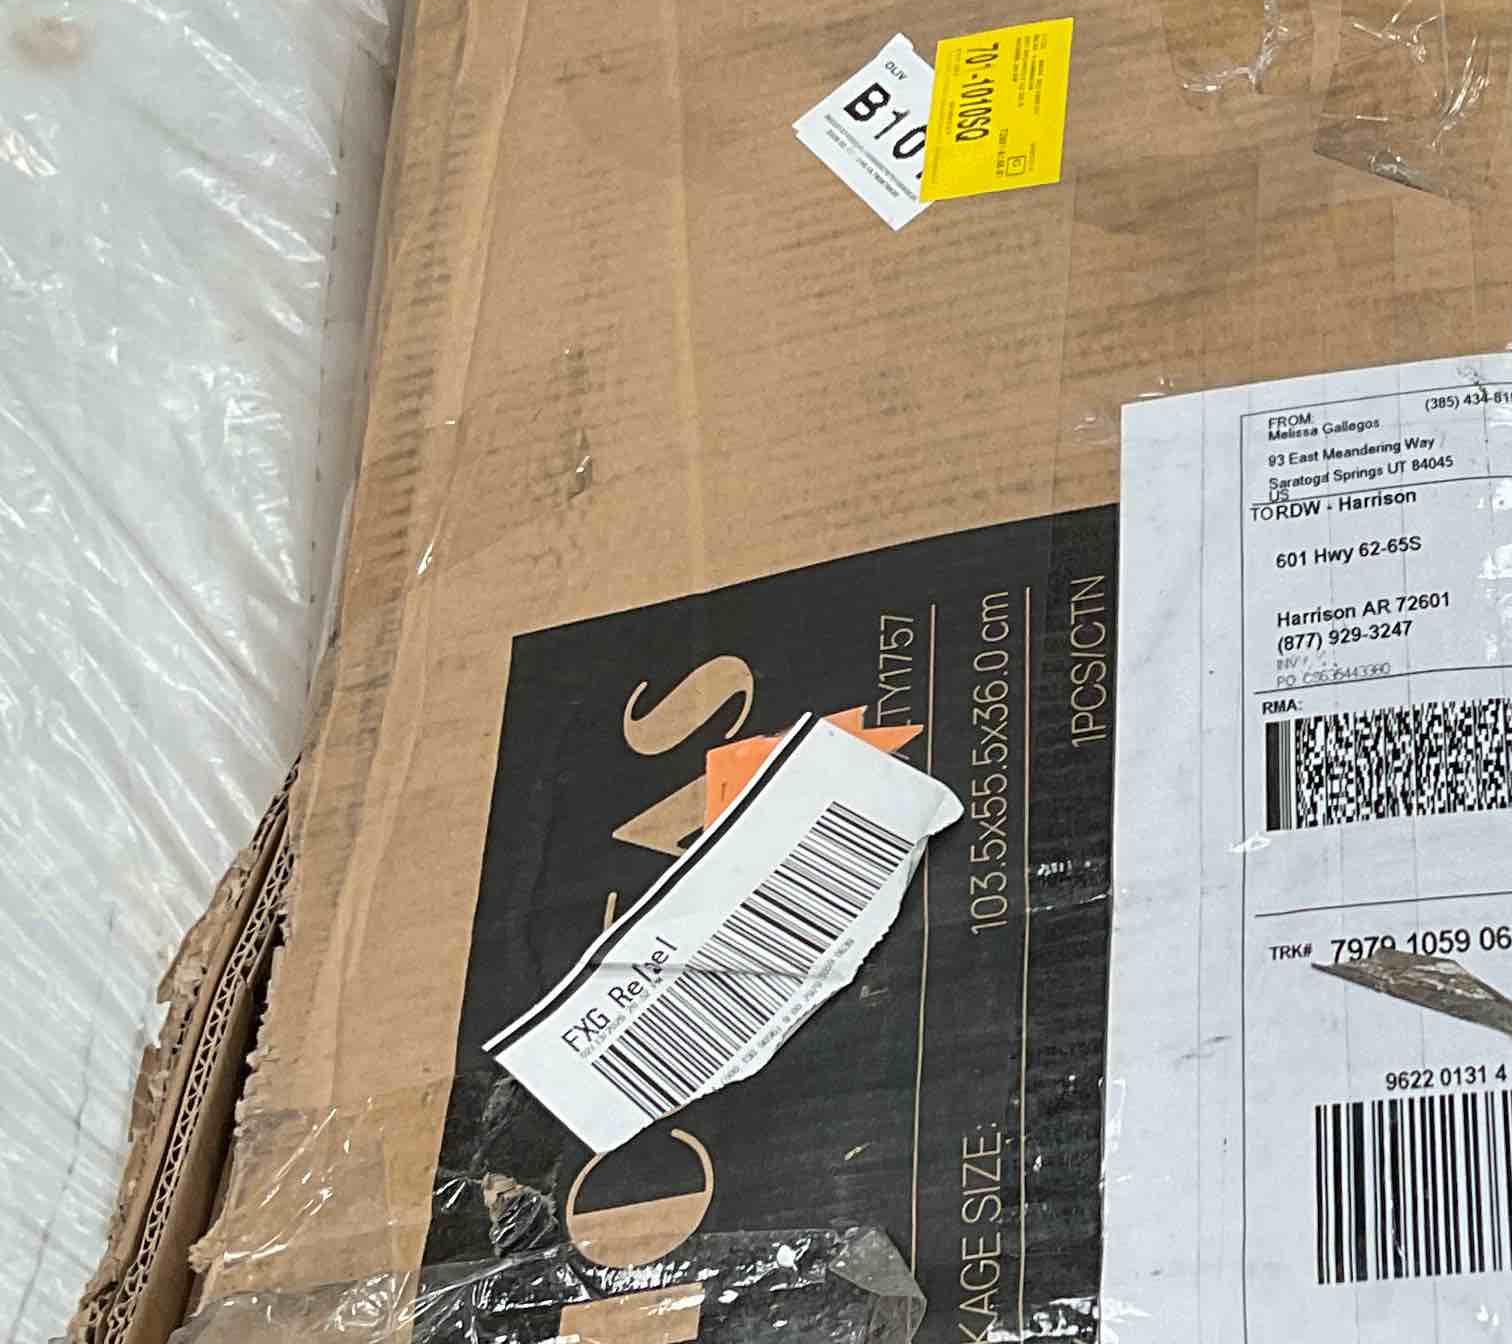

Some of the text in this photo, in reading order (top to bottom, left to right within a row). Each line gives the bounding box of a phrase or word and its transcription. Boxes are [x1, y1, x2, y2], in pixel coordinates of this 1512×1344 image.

[843, 82, 928, 180] B10
[1425, 395, 1460, 412] (385)
[1268, 419, 1380, 441] Melissa Gallegos
[1268, 436, 1436, 467] 93 East Meandering Way
[1269, 455, 1454, 489] Saratoga Springs UT 84045
[1269, 489, 1290, 503] US
[1339, 490, 1417, 512] Harrison
[1276, 535, 1422, 569] 601 Hwy 62-65S
[1277, 591, 1450, 628] Harrison AR 72601
[1277, 620, 1414, 655] (877) 929-3247
[1070, 575, 1107, 748] 1PCS/CTN
[969, 590, 1010, 935] 103.5x55.5x36.0 cm
[1269, 943, 1312, 961] TRK#
[1407, 929, 1471, 956] 1059
[561, 1007, 611, 1053] FXG
[1386, 1065, 1435, 1091] 9622
[1440, 1062, 1488, 1088] 0131
[1494, 1063, 1508, 1082] 4
[961, 1122, 1002, 1223] SIZE:
